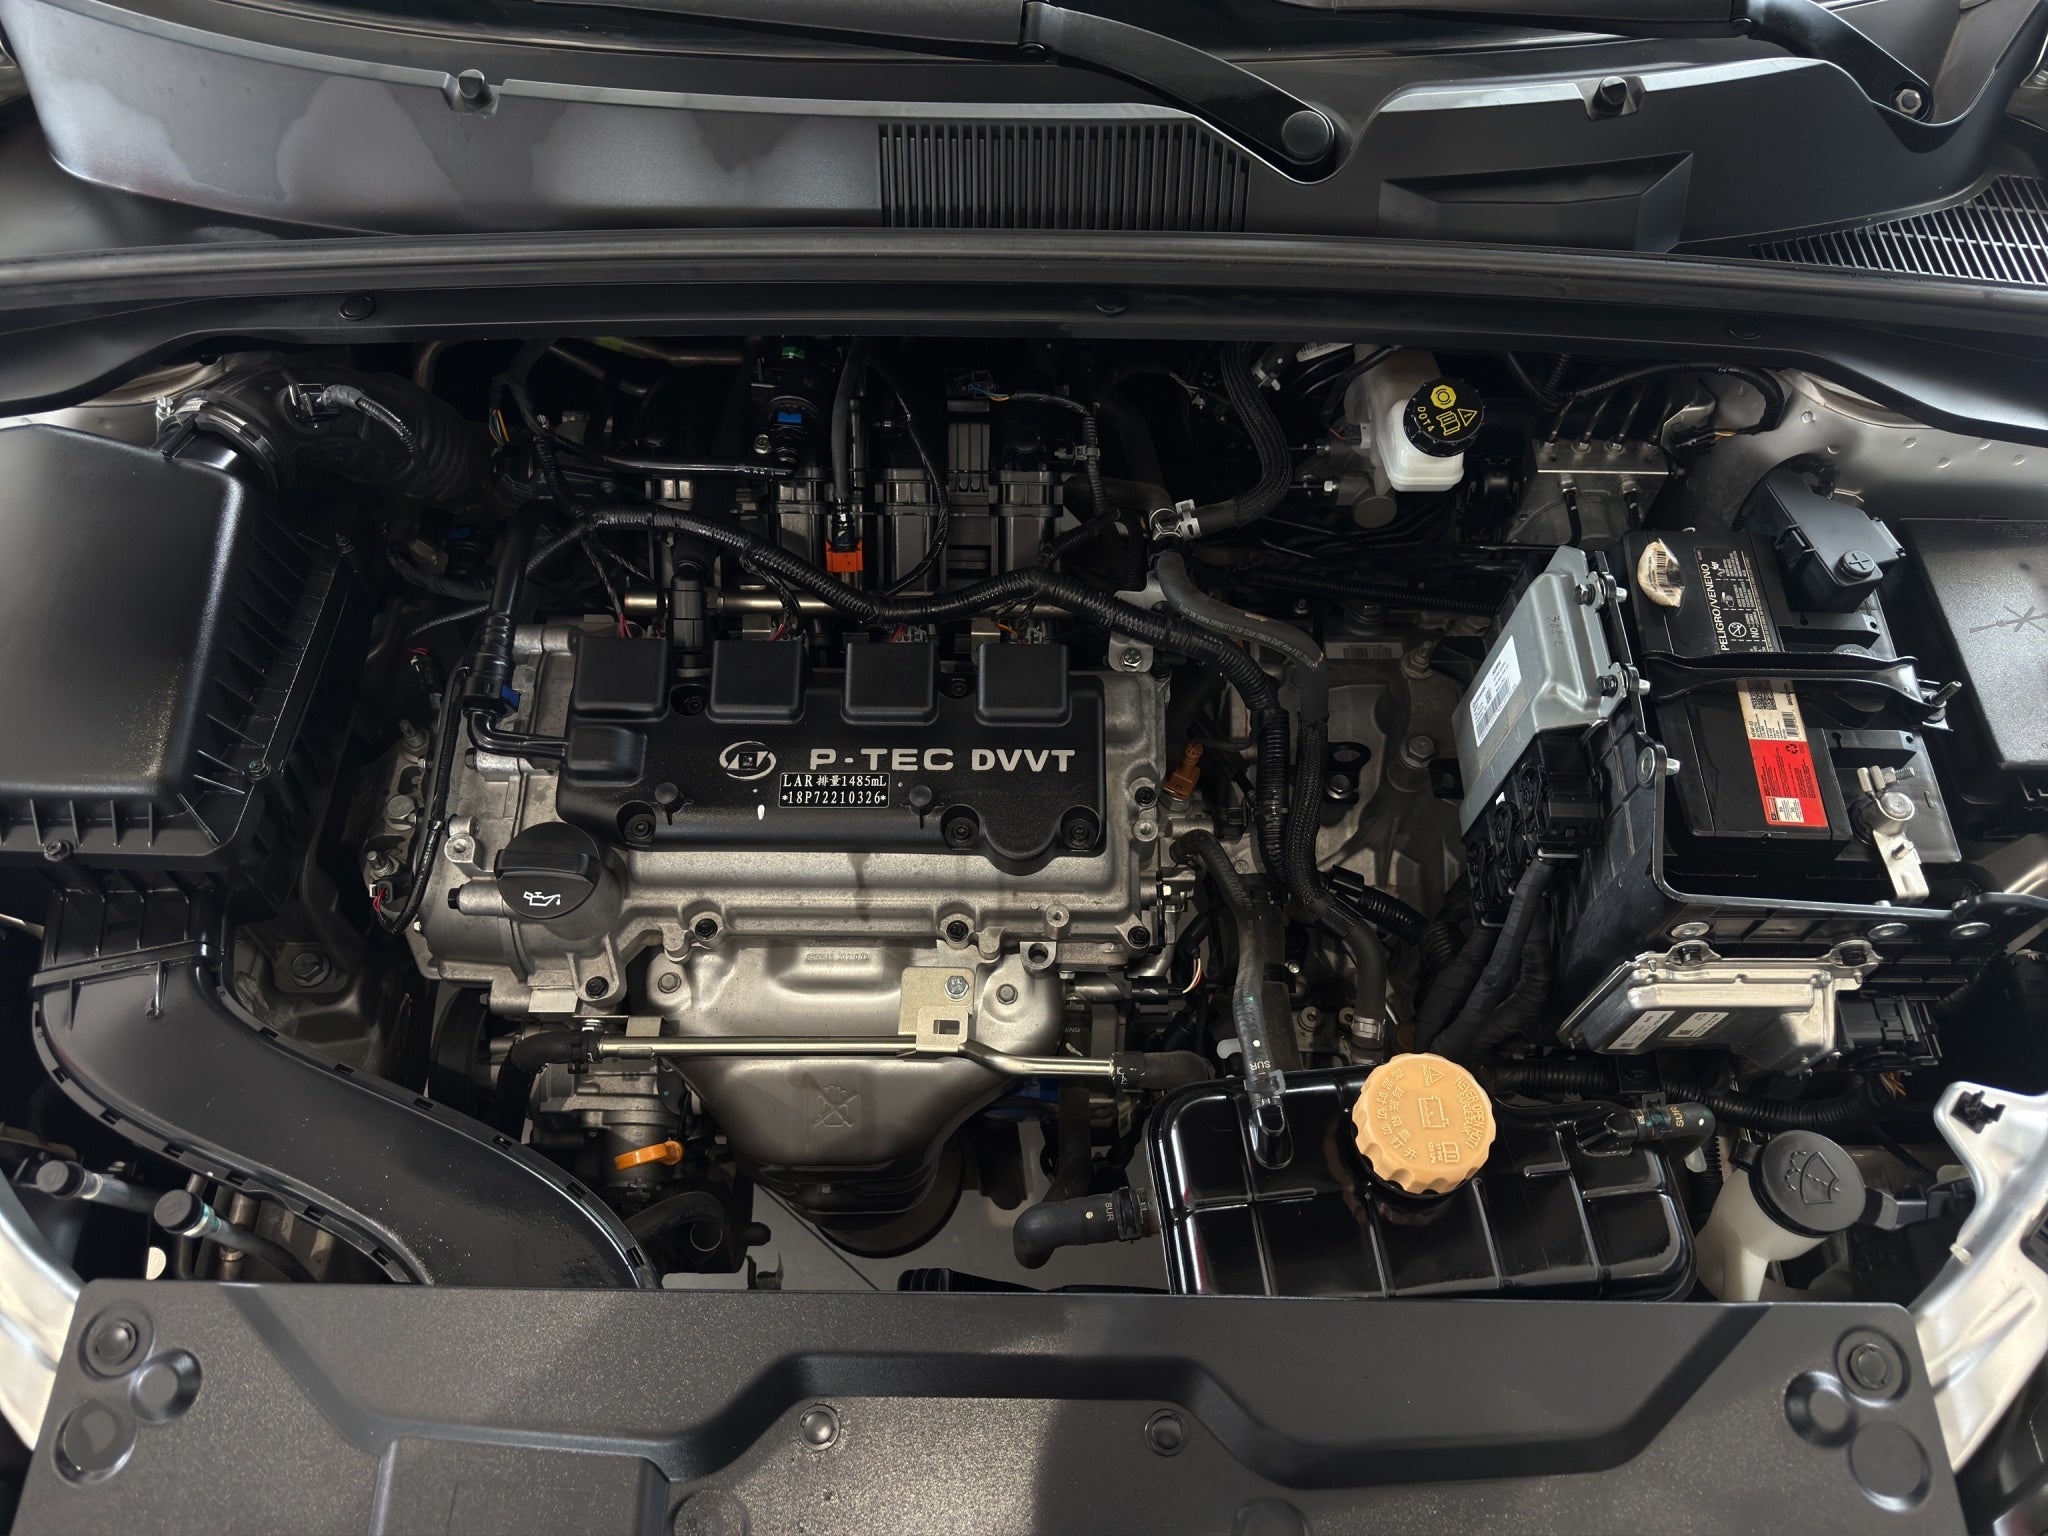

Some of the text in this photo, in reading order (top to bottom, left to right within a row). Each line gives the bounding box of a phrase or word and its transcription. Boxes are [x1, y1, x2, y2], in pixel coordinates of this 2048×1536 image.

[1700, 562, 1730, 651] PELIGRO/VENENO
[971, 748, 1075, 772] DVVT
[783, 774, 813, 787] LAR
[1249, 1059, 1271, 1071] SUR
[1454, 1076, 1478, 1102] NEVER
[1469, 1104, 1484, 1127] OPEN
[1456, 1091, 1474, 1135] SURGE TANK
[1671, 1106, 1684, 1127] SUR
[1103, 1202, 1115, 1222] SUR
